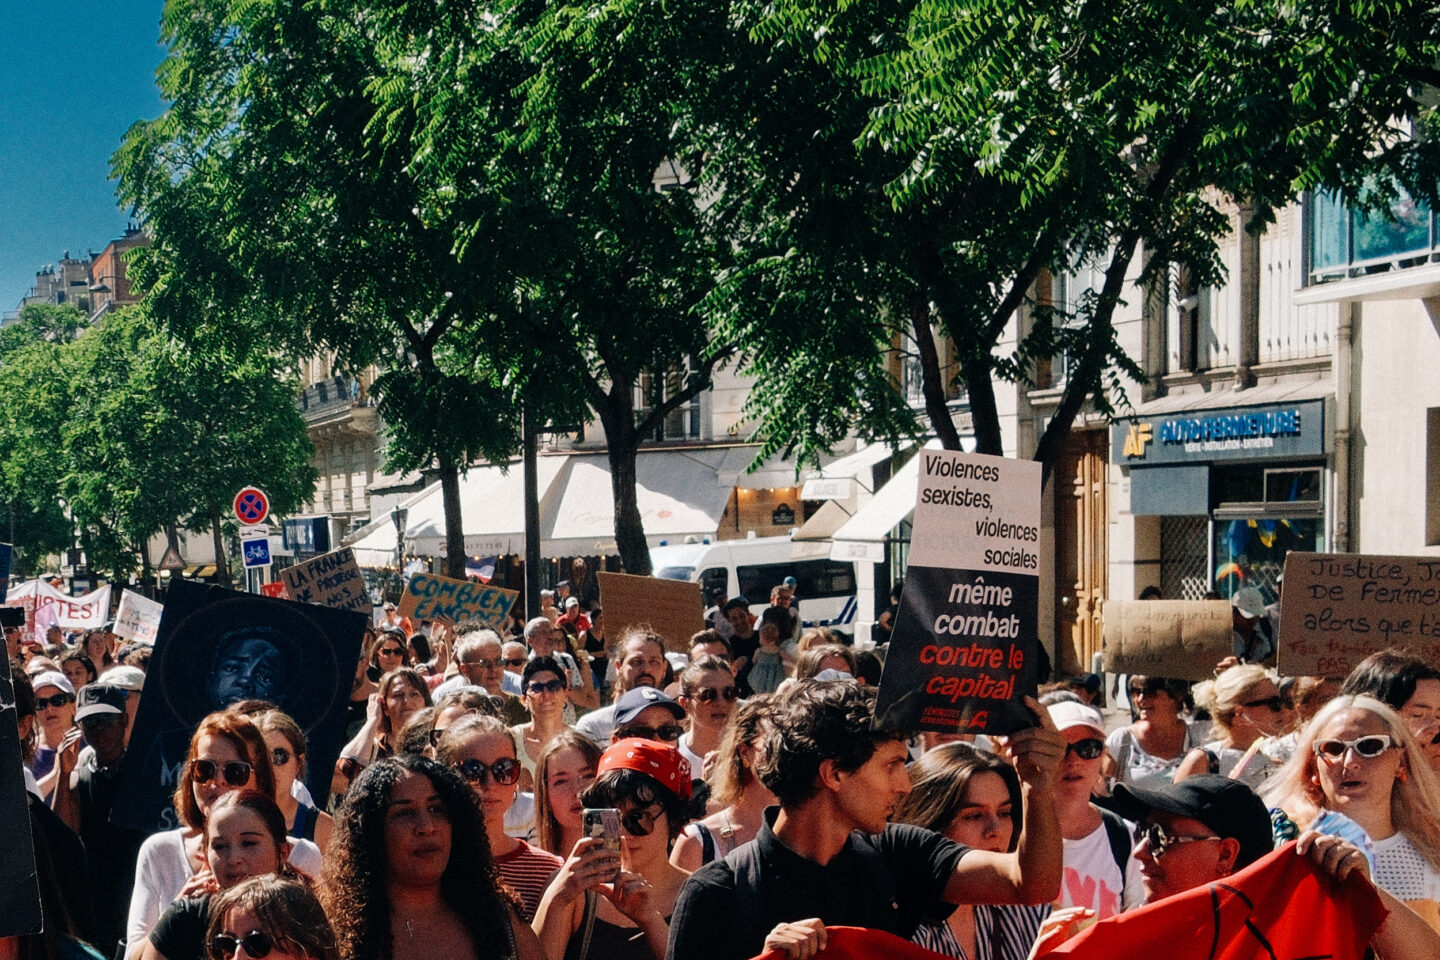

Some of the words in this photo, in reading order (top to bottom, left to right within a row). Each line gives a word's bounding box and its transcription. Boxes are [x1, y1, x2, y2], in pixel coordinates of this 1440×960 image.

[1123, 423, 1152, 456] AF
[925, 455, 999, 482] Violences
[921, 485, 993, 513] sexistes,
[975, 516, 1038, 543] violences
[288, 570, 308, 589] LA
[306, 549, 352, 579] FRANCE
[984, 547, 1038, 569] sociales
[1310, 558, 1410, 586] Justice,
[408, 575, 516, 611] COMBIEN
[948, 576, 1013, 607] même
[934, 611, 1020, 639] combat
[1304, 607, 1370, 633] alors
[1379, 619, 1412, 641] que
[919, 642, 1003, 669] contre
[1008, 643, 1024, 670] le
[926, 672, 1015, 703] capital
